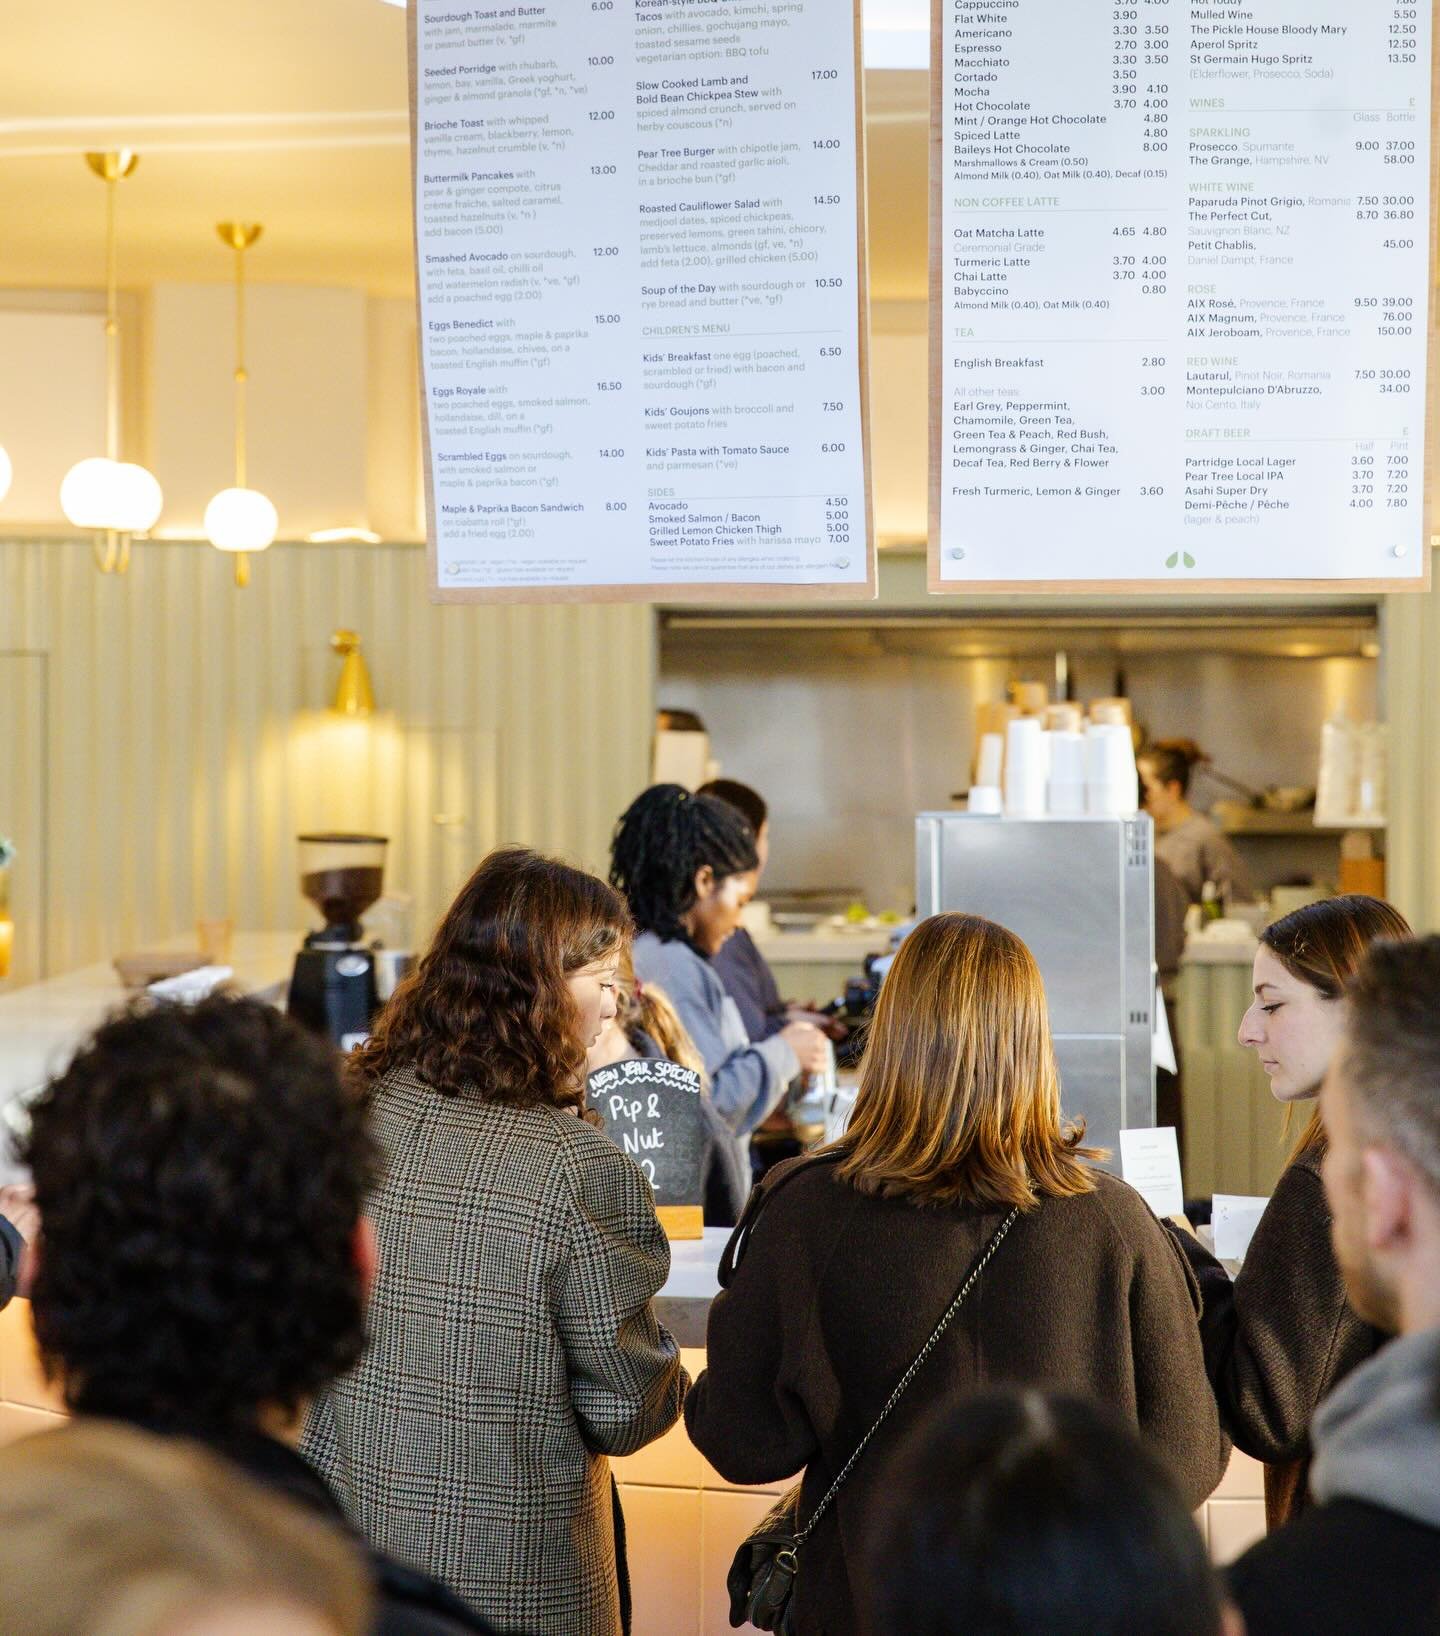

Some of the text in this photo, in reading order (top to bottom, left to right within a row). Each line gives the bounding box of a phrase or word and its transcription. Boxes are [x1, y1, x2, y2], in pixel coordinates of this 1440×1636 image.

[424, 1, 613, 24] Sourdough Toast and Butter 6.00
[954, 10, 1137, 24] Flat White 3.90
[1191, 10, 1416, 19] Mulled Wine 5.50
[955, 25, 1169, 38] Americano 3.30 3.50
[954, 40, 1168, 54] Espresso 2.70 3.00
[1190, 40, 1416, 51] Aperol Spritz 12.50
[424, 66, 457, 77] Seeded
[458, 64, 496, 74] Porridge
[588, 56, 614, 66] 10.00
[954, 55, 1168, 67] Macchiato 3.30 3.50
[636, 70, 838, 91] Slow Cooked Lamb and 17.00
[636, 94, 658, 104] Bold
[660, 94, 684, 103] Bean
[686, 91, 732, 102] Chickpea
[734, 90, 759, 99] Stew
[954, 99, 1168, 112] Hot Chocolate 3.70 4.00
[424, 120, 458, 131] Brioche
[460, 120, 484, 128] Toast
[588, 110, 615, 121] 12.00
[954, 128, 1168, 142] Spiced Latte 4.80
[638, 150, 658, 159] Pear
[660, 149, 681, 158] Tree
[683, 148, 715, 158] Burger
[813, 140, 840, 149] 14.00
[1189, 156, 1208, 165] The
[1210, 156, 1252, 167] Grange,
[1384, 155, 1415, 164] 58.00
[424, 173, 469, 184] Buttermilk
[471, 171, 514, 181] Pancakes
[591, 165, 616, 175] 13.00
[639, 203, 677, 213] Roasted
[678, 201, 732, 212] Cauliflower
[734, 199, 760, 209] Salad
[814, 195, 840, 205] 14.50
[954, 197, 1060, 208] NON COFFEE LATTE
[954, 227, 1167, 238] Oat Matcha Latte 4.65 4.80
[425, 253, 467, 264] Smashed
[468, 252, 508, 262] Avocado
[593, 247, 619, 256] 12.00
[1187, 299, 1205, 308] AIX
[1354, 298, 1377, 307] 9.50
[1382, 298, 1413, 307] 39.00
[429, 322, 451, 332] Eggs
[453, 319, 494, 329] Benedict
[595, 314, 621, 324] 15.00
[642, 324, 731, 336] CHILDREN'S MENU
[954, 357, 1166, 370] English Breakfast 2.80
[1187, 356, 1238, 366] RED WINE
[954, 402, 1070, 412] Earl Grey, Peppermint,
[437, 452, 483, 462] Scrambled
[485, 452, 507, 462] Eggs
[599, 449, 624, 458] 14.00
[671, 448, 697, 457] Pasta
[699, 446, 720, 456] with
[721, 446, 758, 455] Tomato
[759, 445, 789, 454] Sauce
[821, 443, 845, 453] 6.00
[1185, 470, 1408, 481] Pear Tree Local IPA 3.70 7.20
[952, 486, 1163, 498] Fresh Turmeric, Lemon & Ginger 3.60
[1185, 484, 1408, 497] Asahi Super Dry 3.70 7.20
[441, 502, 627, 514] Maple & Paprika Bacon Sandwich 8.00
[649, 523, 849, 536] Grilled Lemon Chicken Thigh 5.00
[589, 1061, 700, 1090] NEW YEAR SPECIAL
[609, 1093, 660, 1122] Pip &
[623, 1127, 664, 1153] Nut
